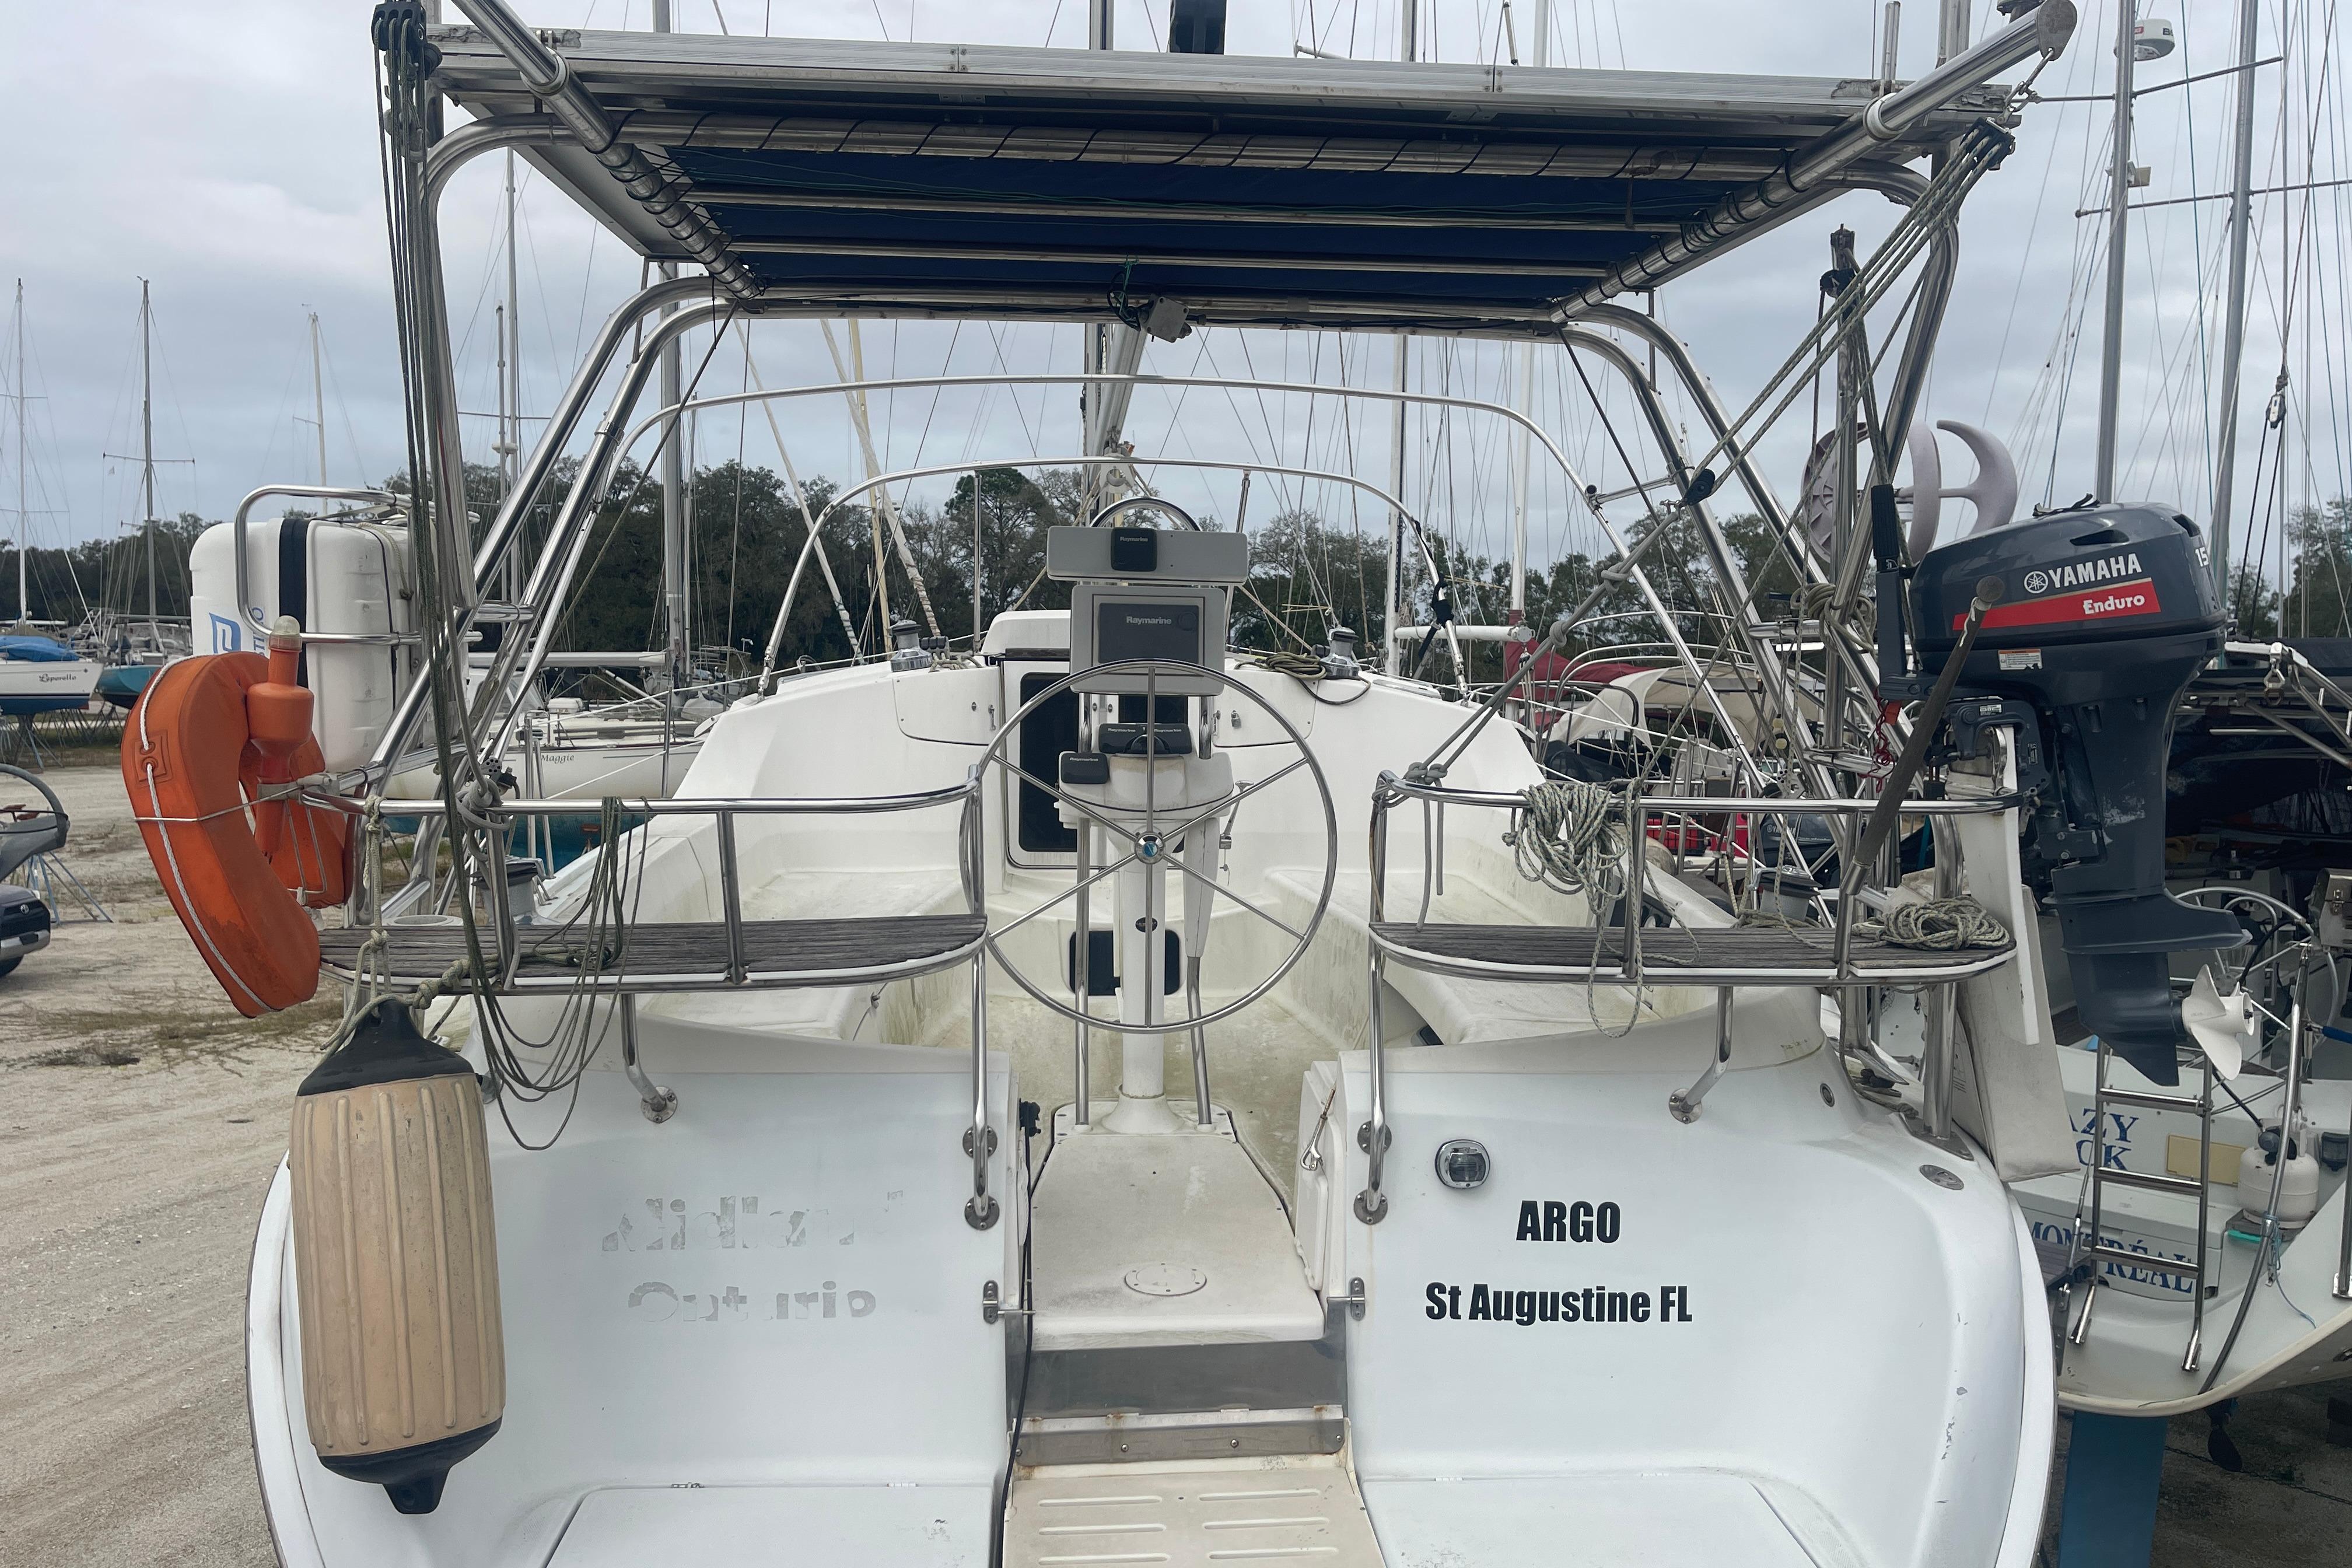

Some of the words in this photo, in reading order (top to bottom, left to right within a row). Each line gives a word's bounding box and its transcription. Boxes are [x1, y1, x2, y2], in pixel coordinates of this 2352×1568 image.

[2048, 553, 2142, 589] YAMAHA
[2083, 596, 2146, 615] Enduro
[1126, 616, 1172, 625] Raymarine
[541, 754, 574, 764] Maggie
[1516, 1200, 1620, 1243] ARGO
[1426, 1282, 1462, 1320] St
[1468, 1283, 1650, 1326] Augustine
[1660, 1286, 1692, 1322] FL
